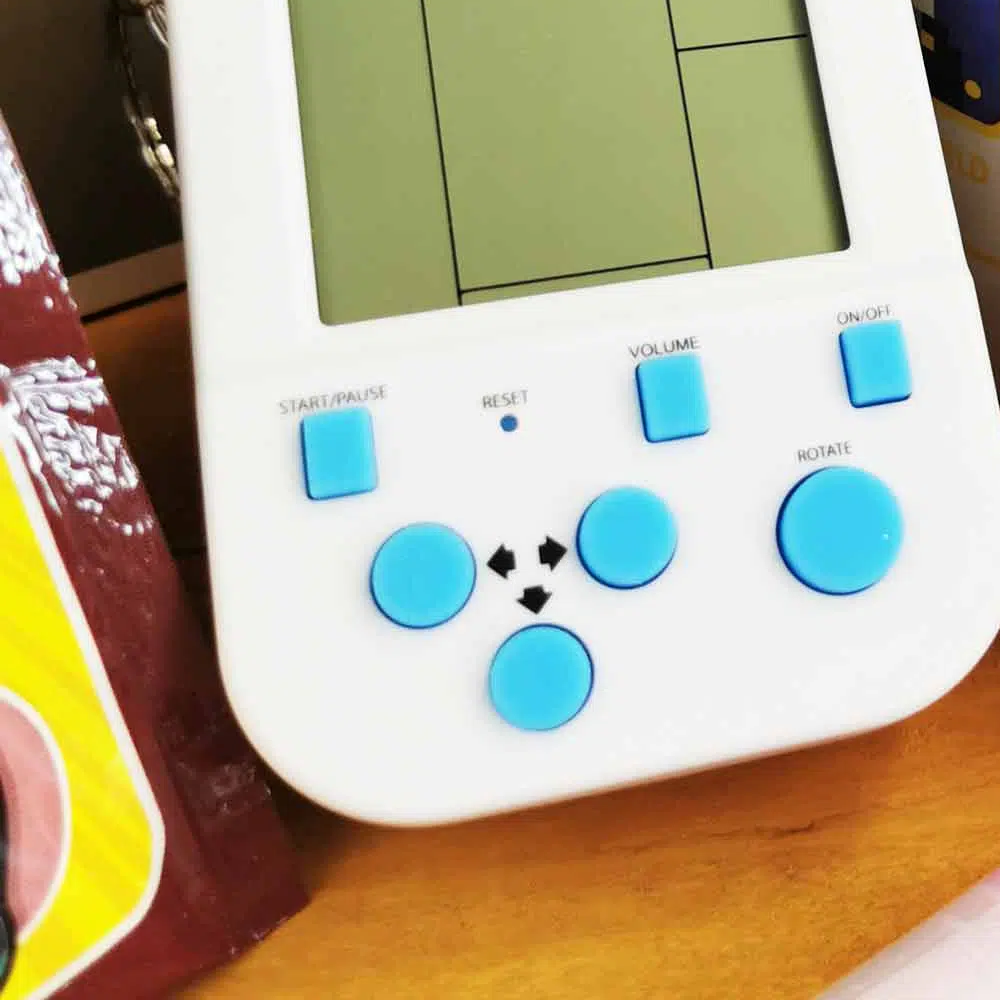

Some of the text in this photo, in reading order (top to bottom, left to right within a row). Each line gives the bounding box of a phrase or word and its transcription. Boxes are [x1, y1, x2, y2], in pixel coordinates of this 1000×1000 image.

[836, 304, 893, 326] ON/OFF
[628, 336, 701, 360] VOLUME
[278, 385, 389, 415] START/PAUSE
[482, 389, 529, 410] RESET
[796, 440, 853, 464] ROTATE
